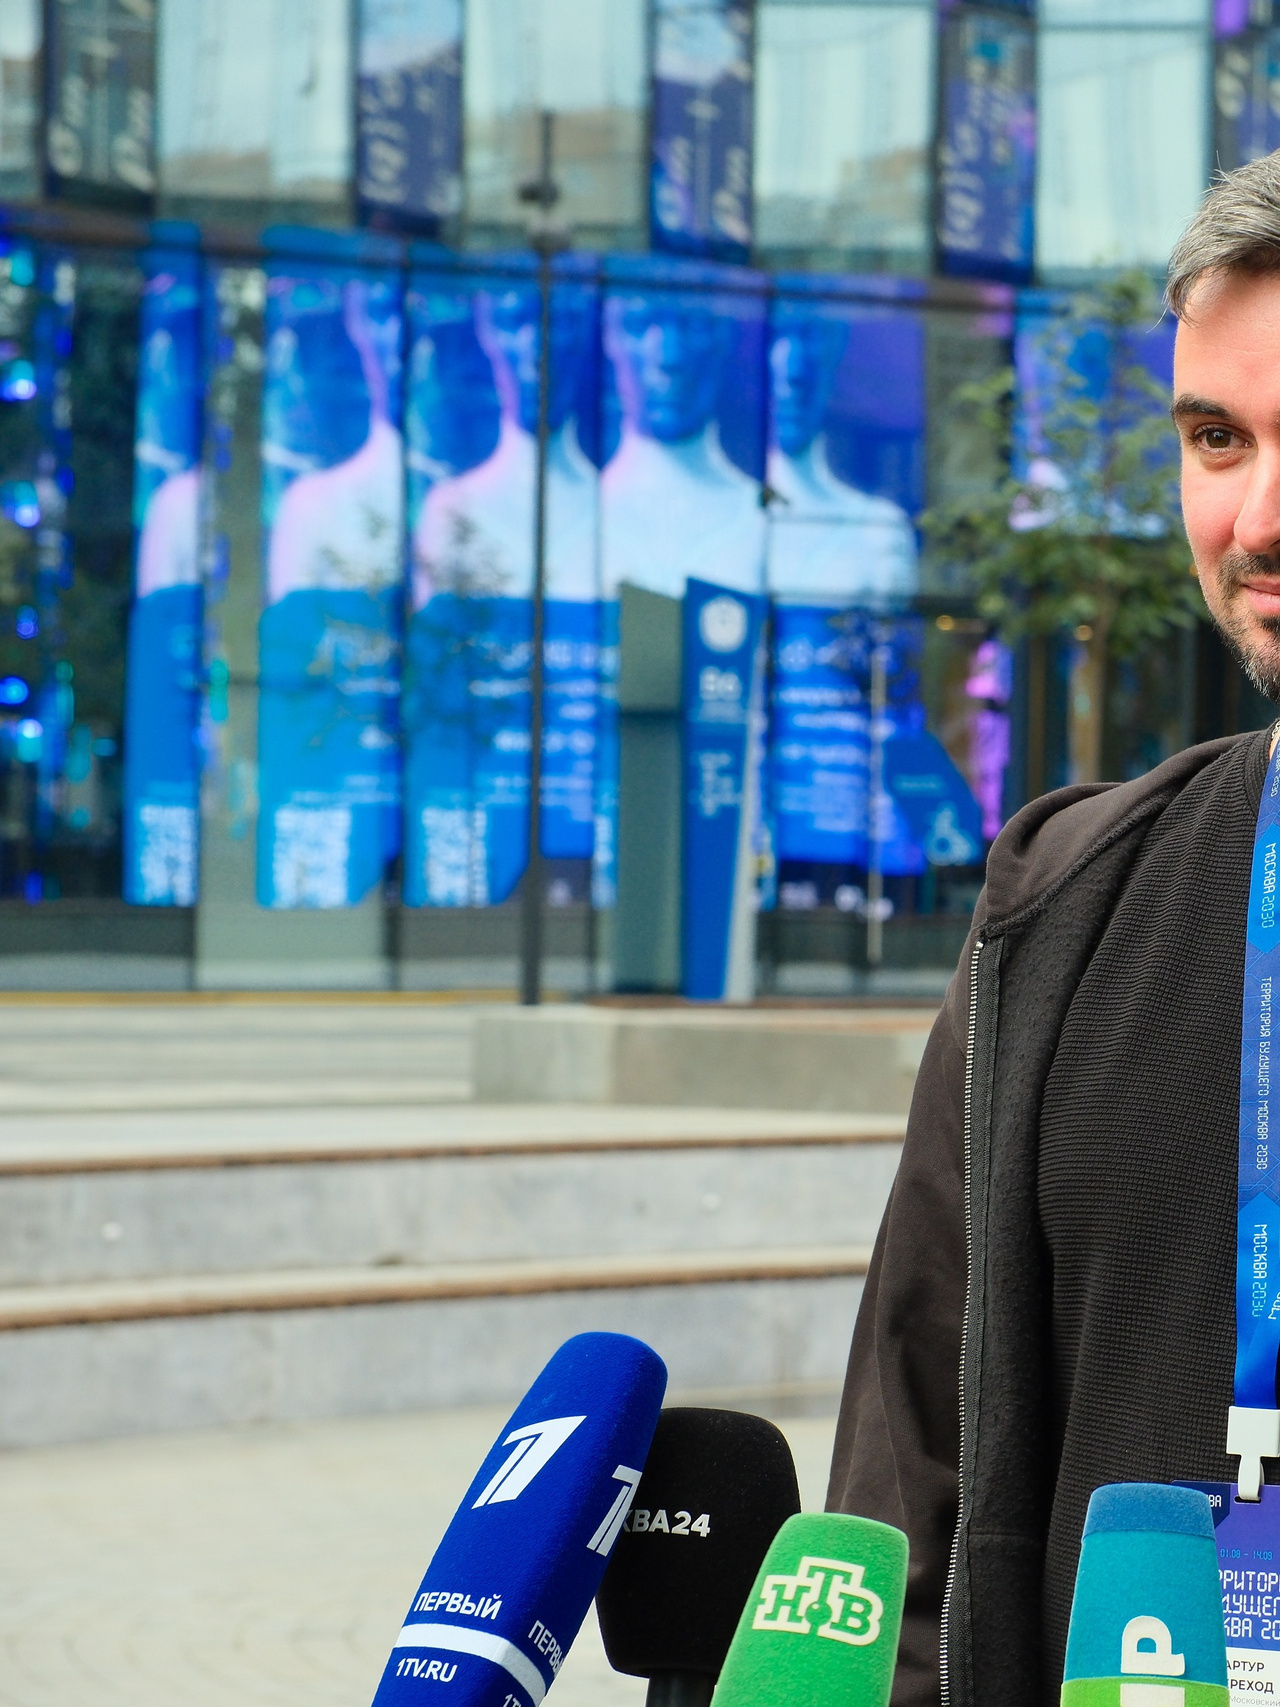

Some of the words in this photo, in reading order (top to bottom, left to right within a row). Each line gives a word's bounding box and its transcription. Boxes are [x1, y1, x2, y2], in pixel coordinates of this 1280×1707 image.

[1262, 842, 1277, 895] МОСКВА
[1261, 895, 1275, 929] 2030
[1260, 976, 1272, 1038] ТЕРРИТОРИЯ
[1258, 1041, 1271, 1096] БУДУЩЕГО
[1257, 1100, 1269, 1140] МОСКВА
[1256, 1144, 1268, 1170] 2030
[1253, 1224, 1268, 1279] МОСКВА
[413, 1592, 503, 1620] ПЕРВЫЙ
[752, 1556, 883, 1645] НТВ
[396, 1658, 458, 1682] 1TV.RU
[1228, 1679, 1275, 1694] РЕХОД
